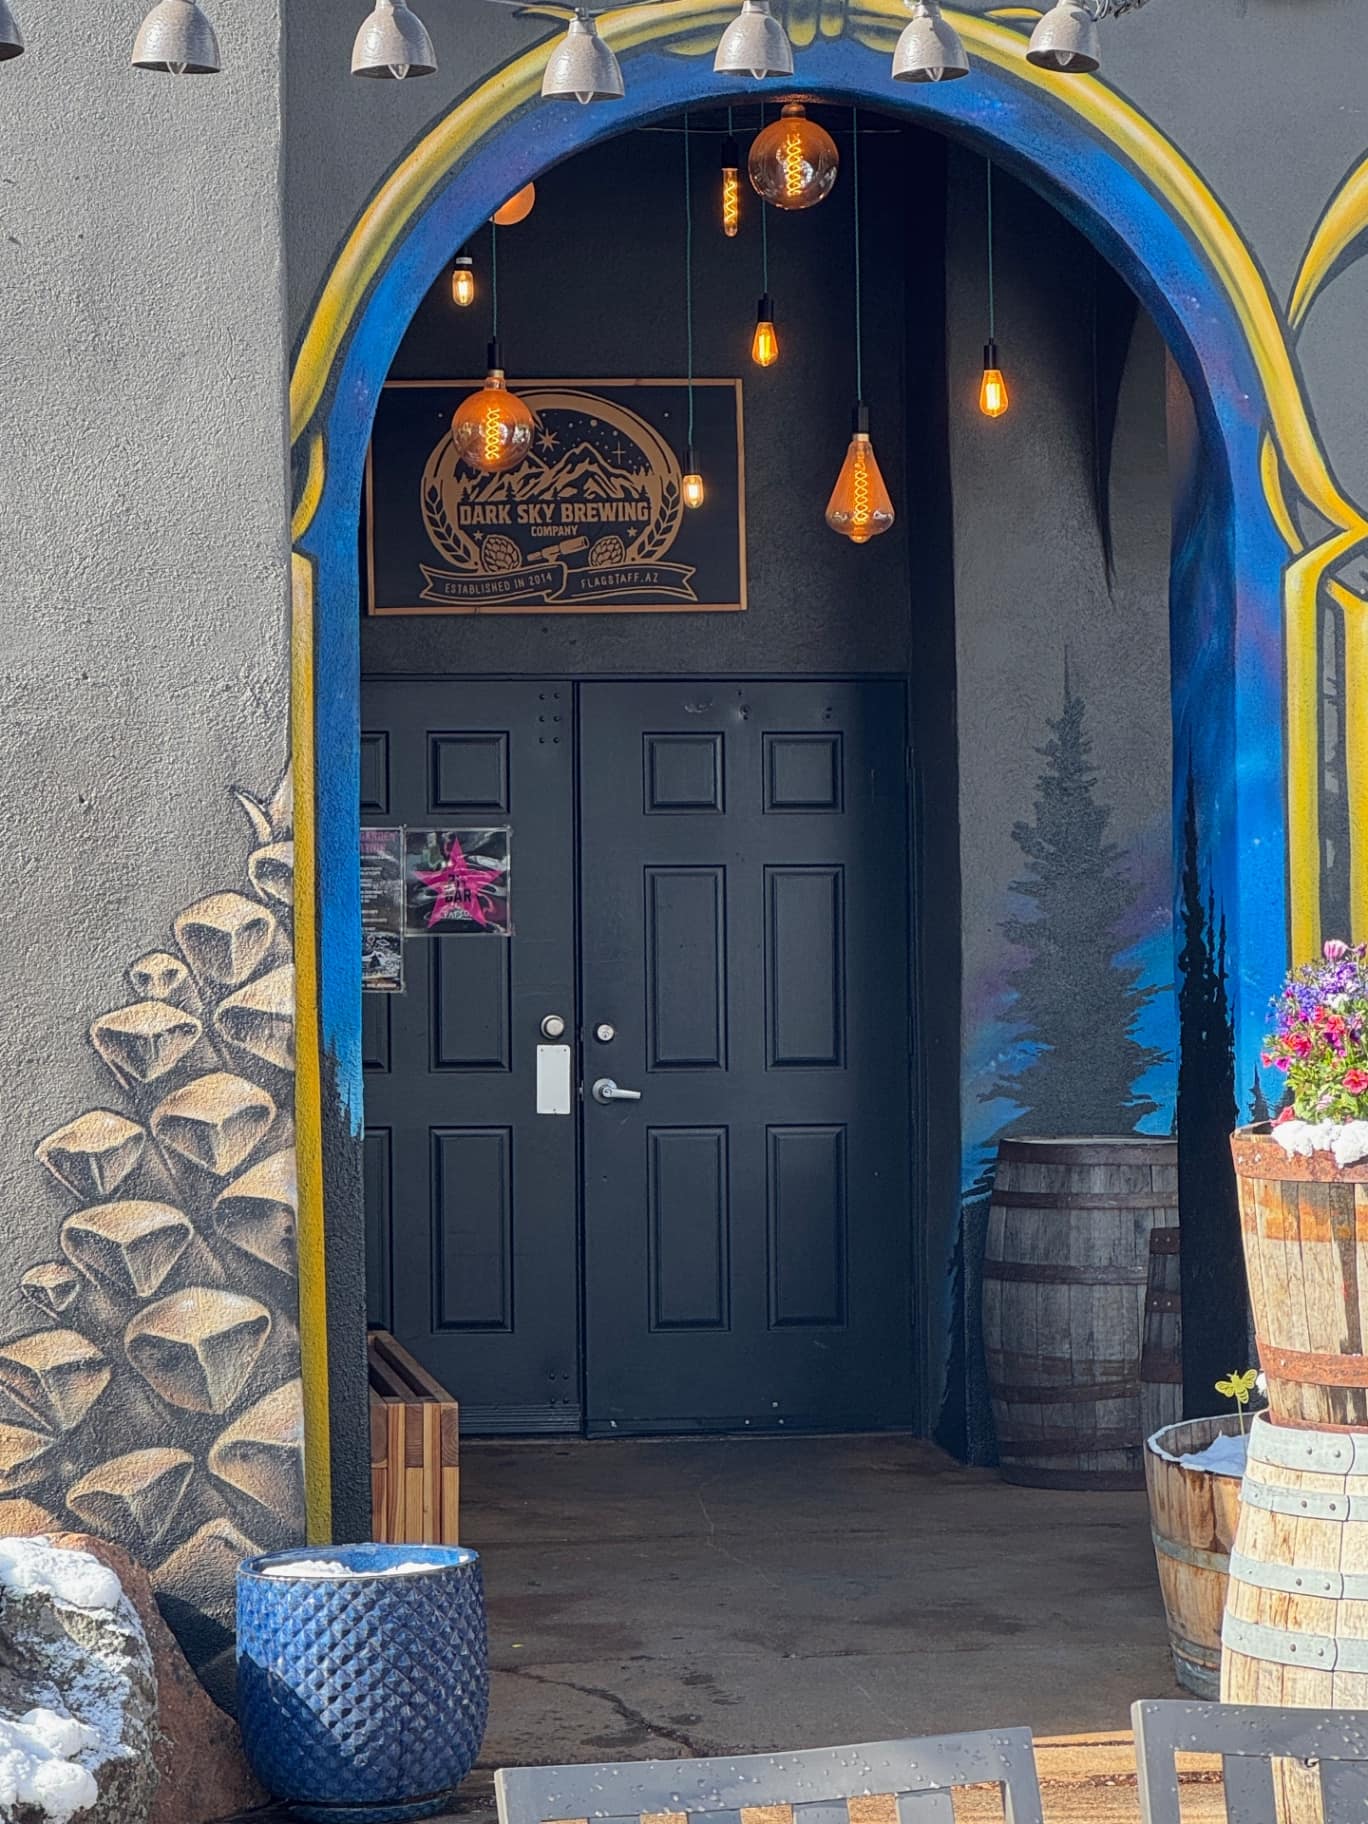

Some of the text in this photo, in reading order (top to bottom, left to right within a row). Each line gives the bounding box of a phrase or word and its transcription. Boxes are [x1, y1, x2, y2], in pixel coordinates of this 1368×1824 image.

[459, 502, 649, 525] DARK SKY BREWING
[531, 525, 578, 537] COMPANY
[445, 572, 553, 594] ESTABLISHED IN 2014
